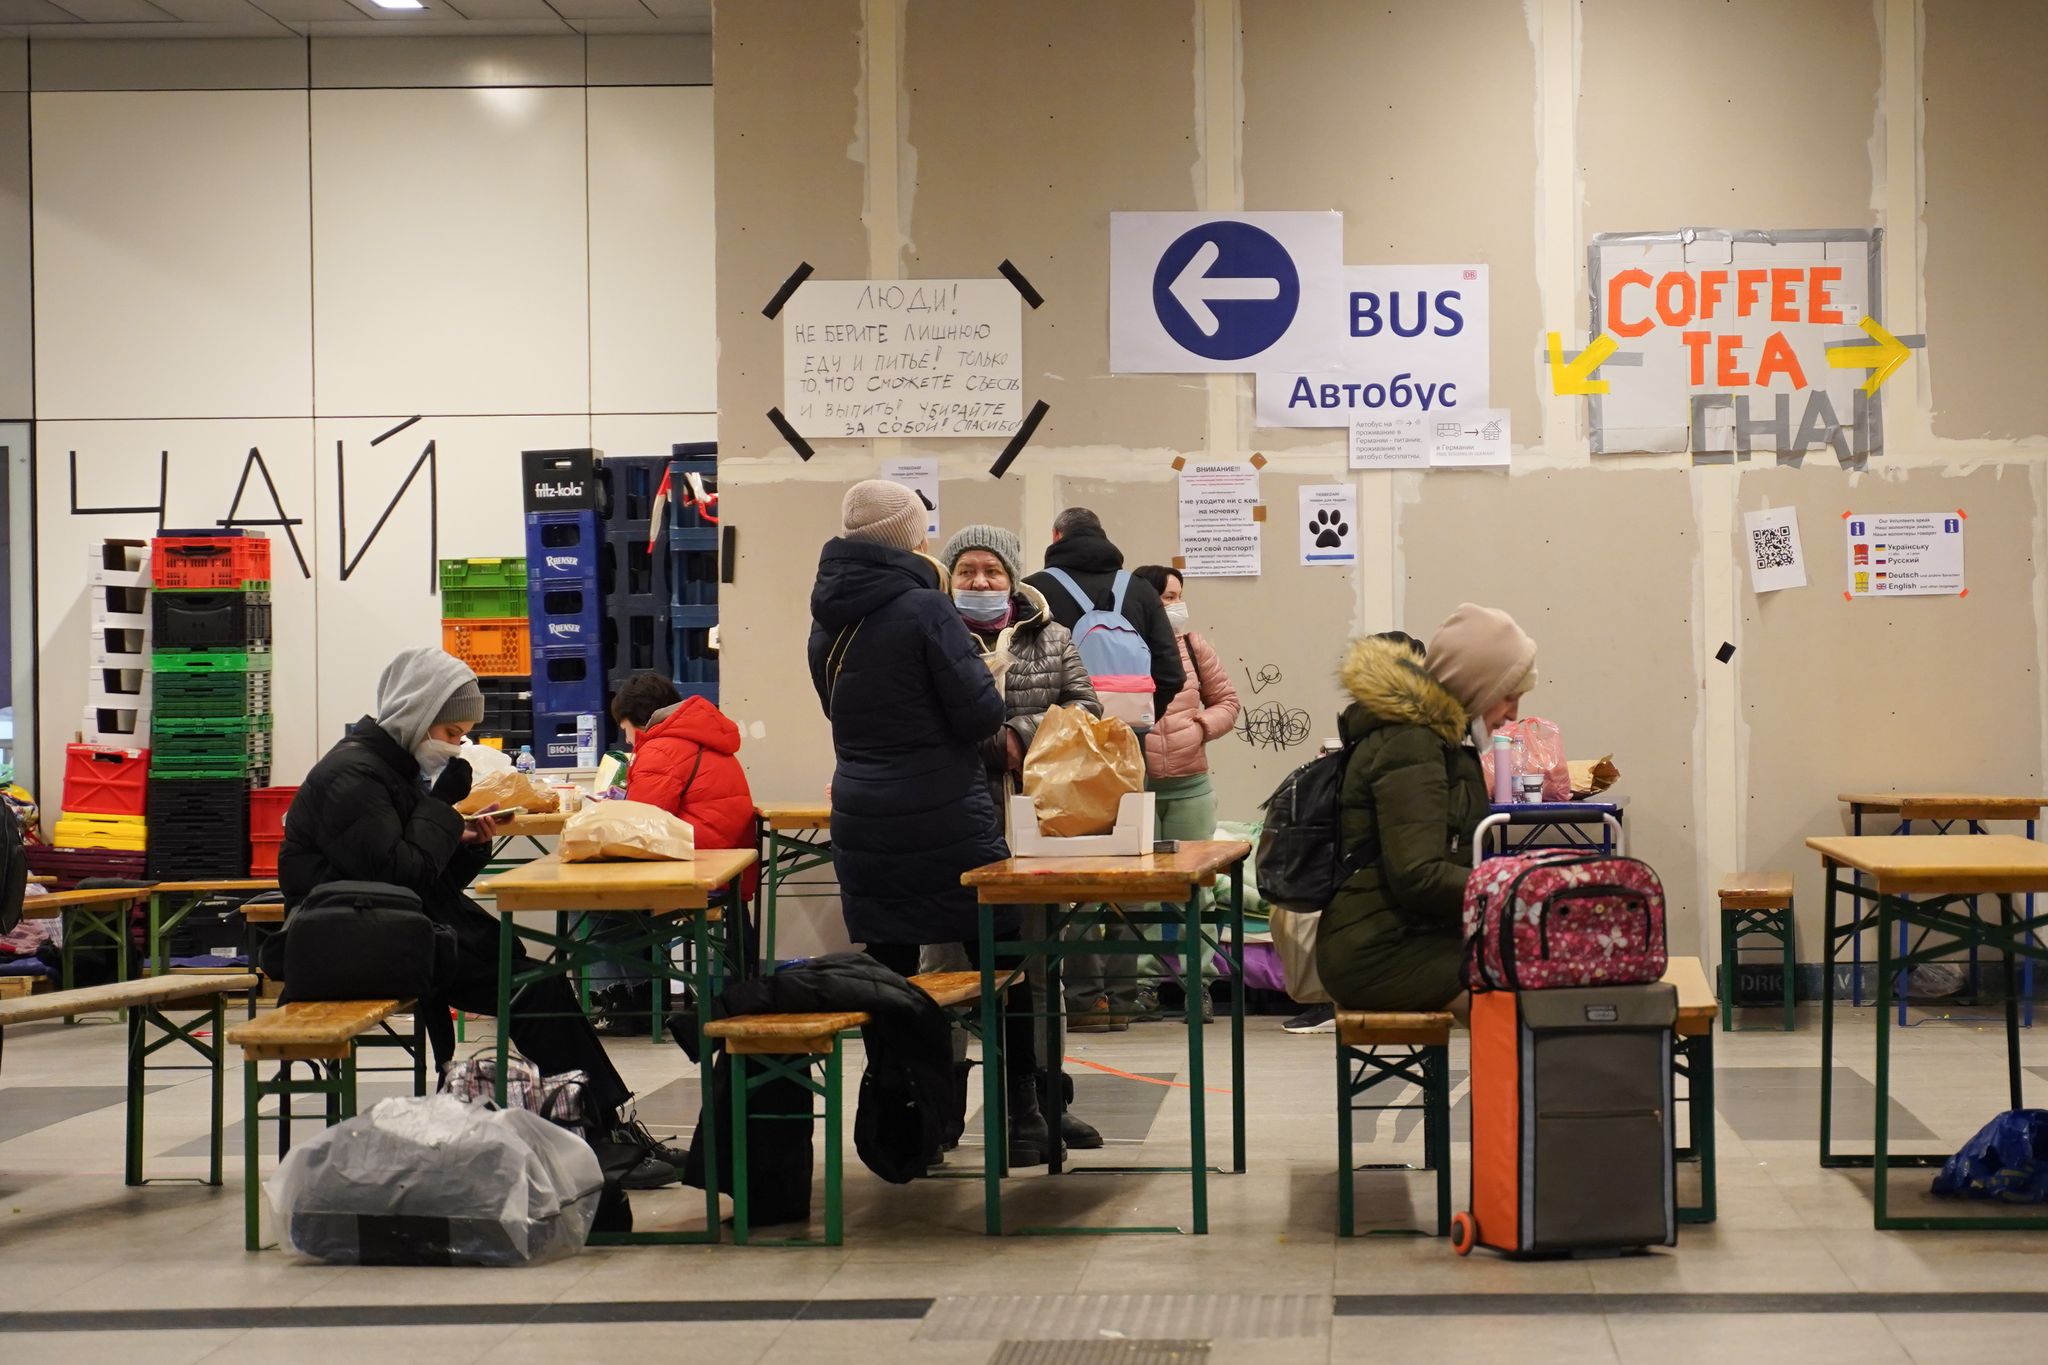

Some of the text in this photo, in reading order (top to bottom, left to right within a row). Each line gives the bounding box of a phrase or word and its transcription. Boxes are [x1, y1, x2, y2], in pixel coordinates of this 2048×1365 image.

[857, 283, 958, 315] ЛЮДИ!
[1608, 266, 1844, 338] COFFEE
[1349, 290, 1464, 338] BUS
[795, 323, 991, 343] НЕ БЕРИТЕ ЛИШНЮЮ
[804, 355, 841, 374] ЕДУ
[853, 354, 863, 372] И
[958, 350, 1008, 368] ТОЛЬКО
[1682, 331, 1808, 391] TEA
[867, 374, 954, 392] СМОЖЕТЕ
[966, 375, 1020, 391] СЪЕСТЬ
[1288, 373, 1457, 411] Автобус
[800, 403, 813, 418] И
[920, 402, 1007, 419] УБИРАЙТЕ
[845, 422, 865, 435] ЗА
[877, 418, 949, 434] СОБОЙ!
[1356, 420, 1382, 429] Автобус
[1442, 444, 1475, 452] Германии
[70, 415, 438, 596] ЧАЙ
[1196, 498, 1226, 506] уходите
[1223, 535, 1252, 543] давайте
[1888, 543, 1930, 552] Українську
[1888, 557, 1920, 565] Русский
[1888, 571, 1919, 579] Deutsch
[1888, 583, 1917, 591] English
